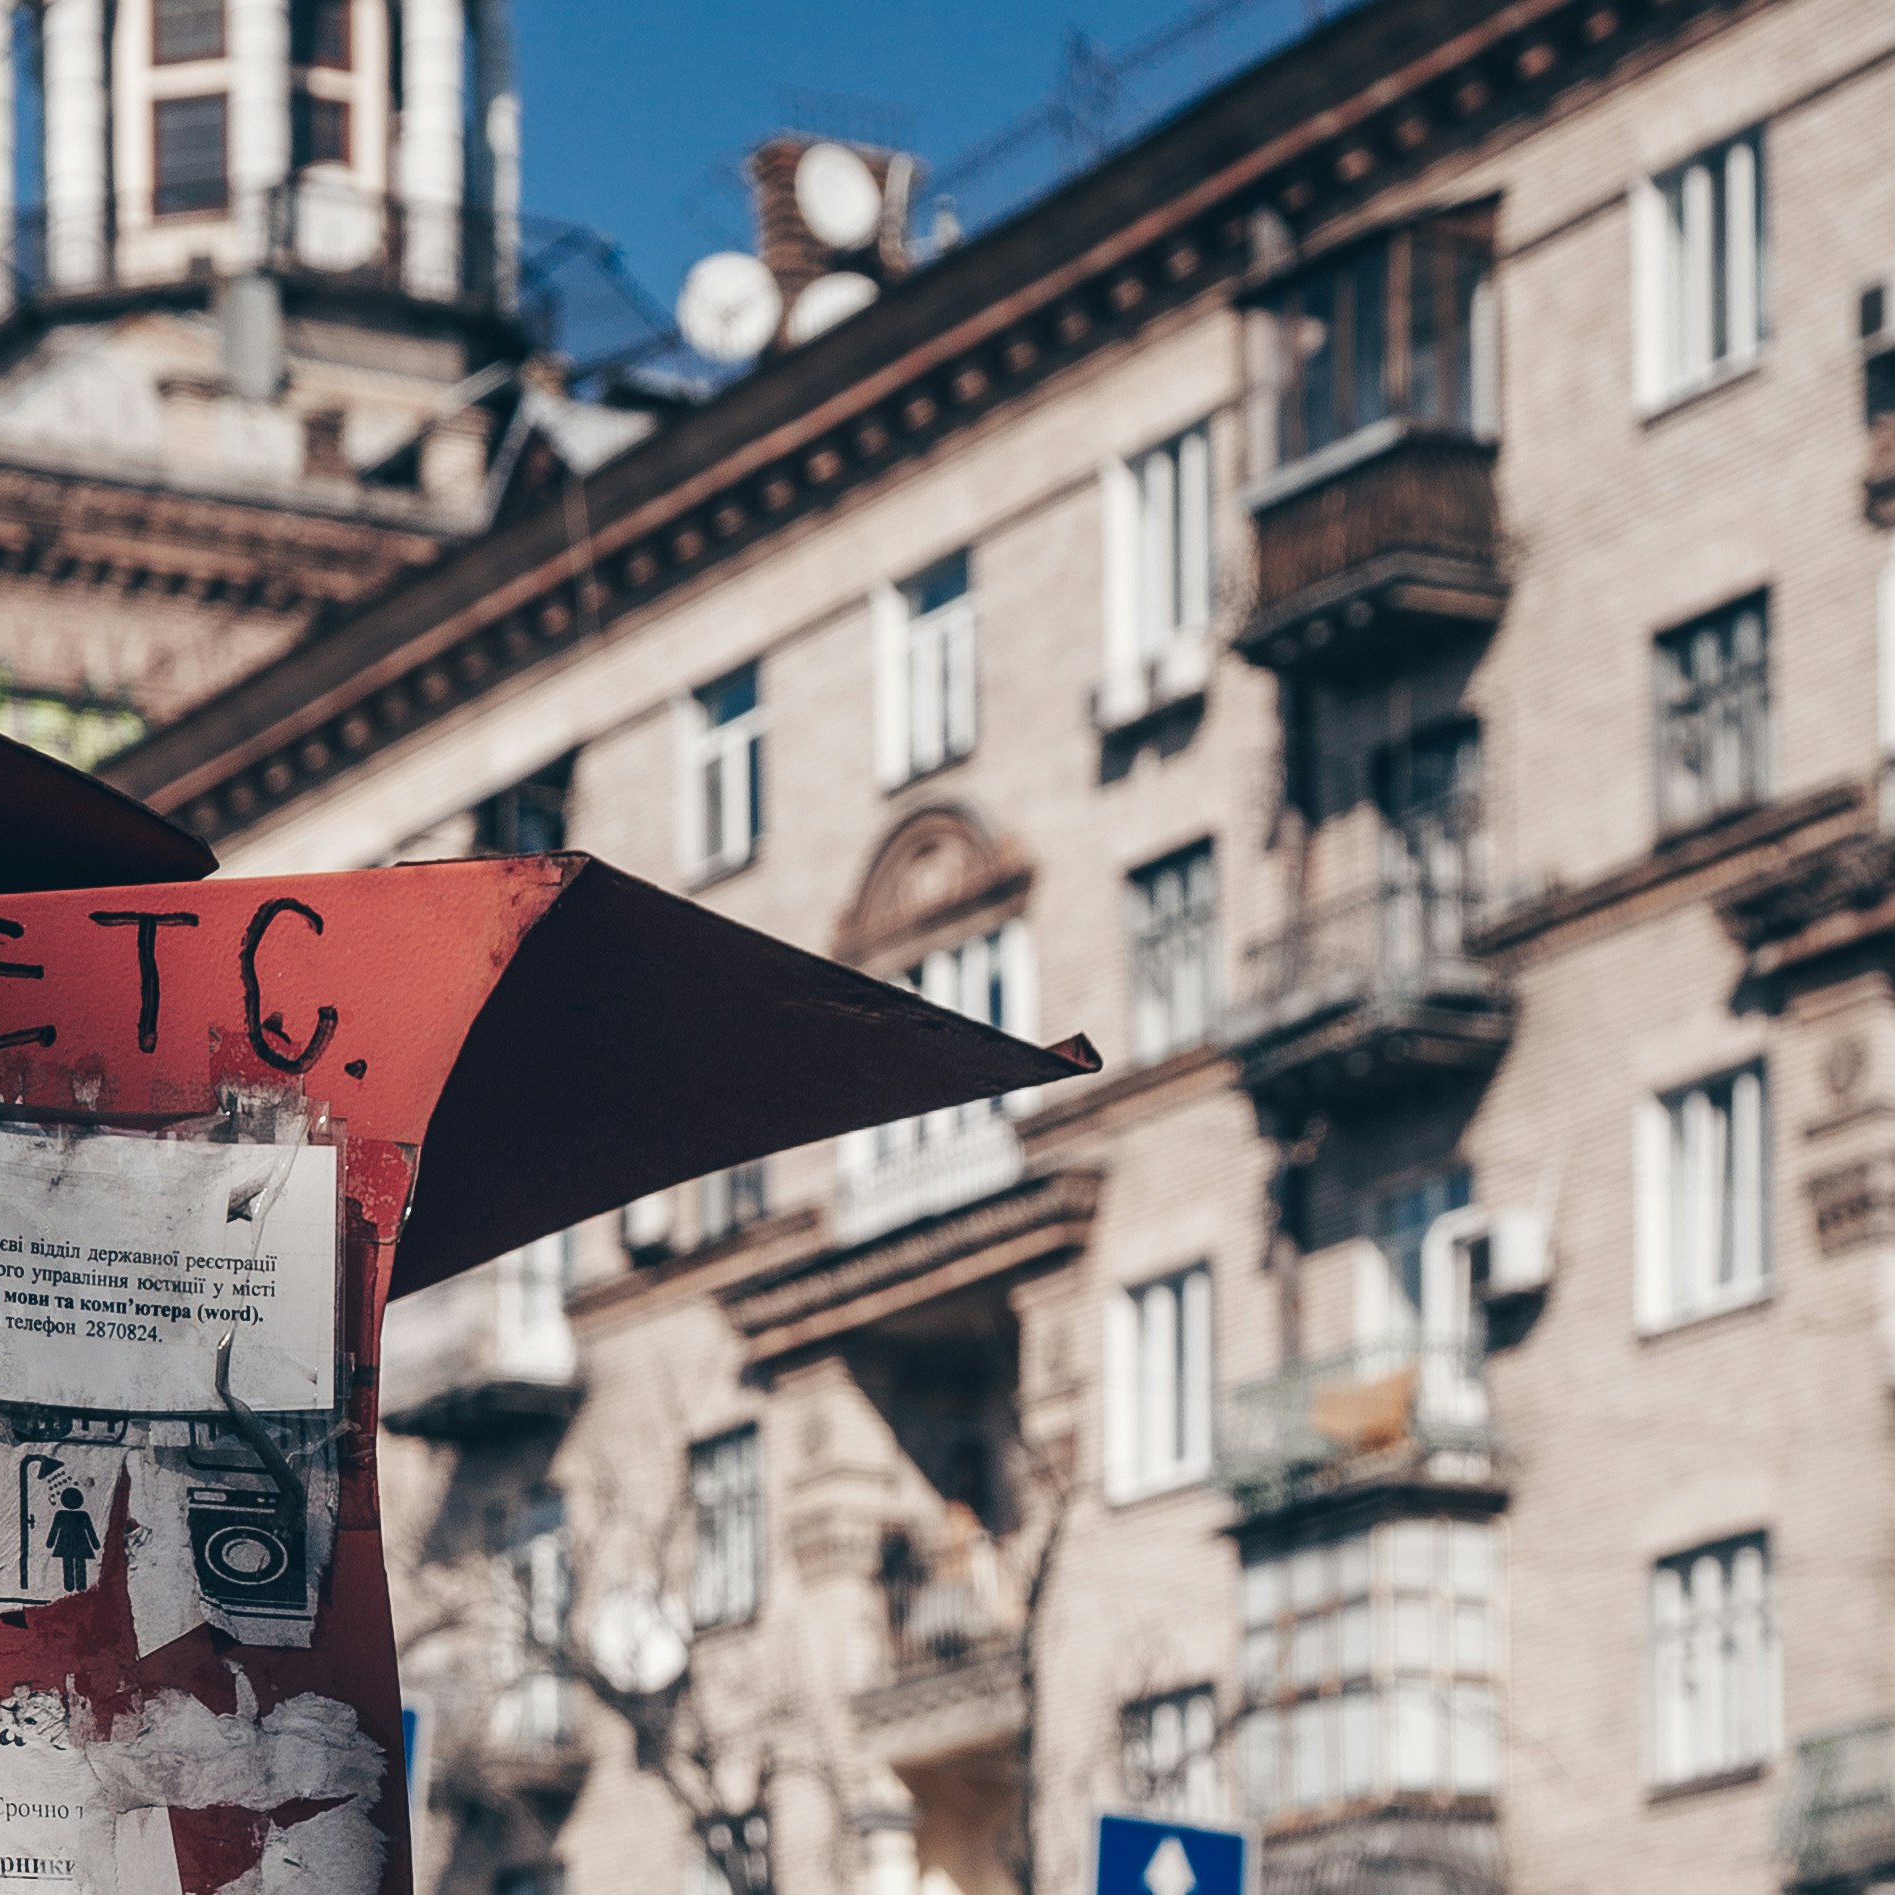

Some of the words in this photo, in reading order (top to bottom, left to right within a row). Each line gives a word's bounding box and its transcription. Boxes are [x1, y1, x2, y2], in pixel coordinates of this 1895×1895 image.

[30, 1240, 80, 1260] відділ
[87, 1247, 180, 1267] державної
[186, 1255, 277, 1274] реєстрації
[31, 1268, 129, 1290] управління
[136, 1276, 206, 1296] юстиції
[212, 1282, 223, 1297] у
[232, 1280, 275, 1298] місті
[4, 1291, 50, 1307] мови
[54, 1294, 75, 1310] та
[197, 1303, 264, 1324] (word).
[5, 1316, 76, 1337] телефон
[85, 1319, 163, 1343] 2870824.
